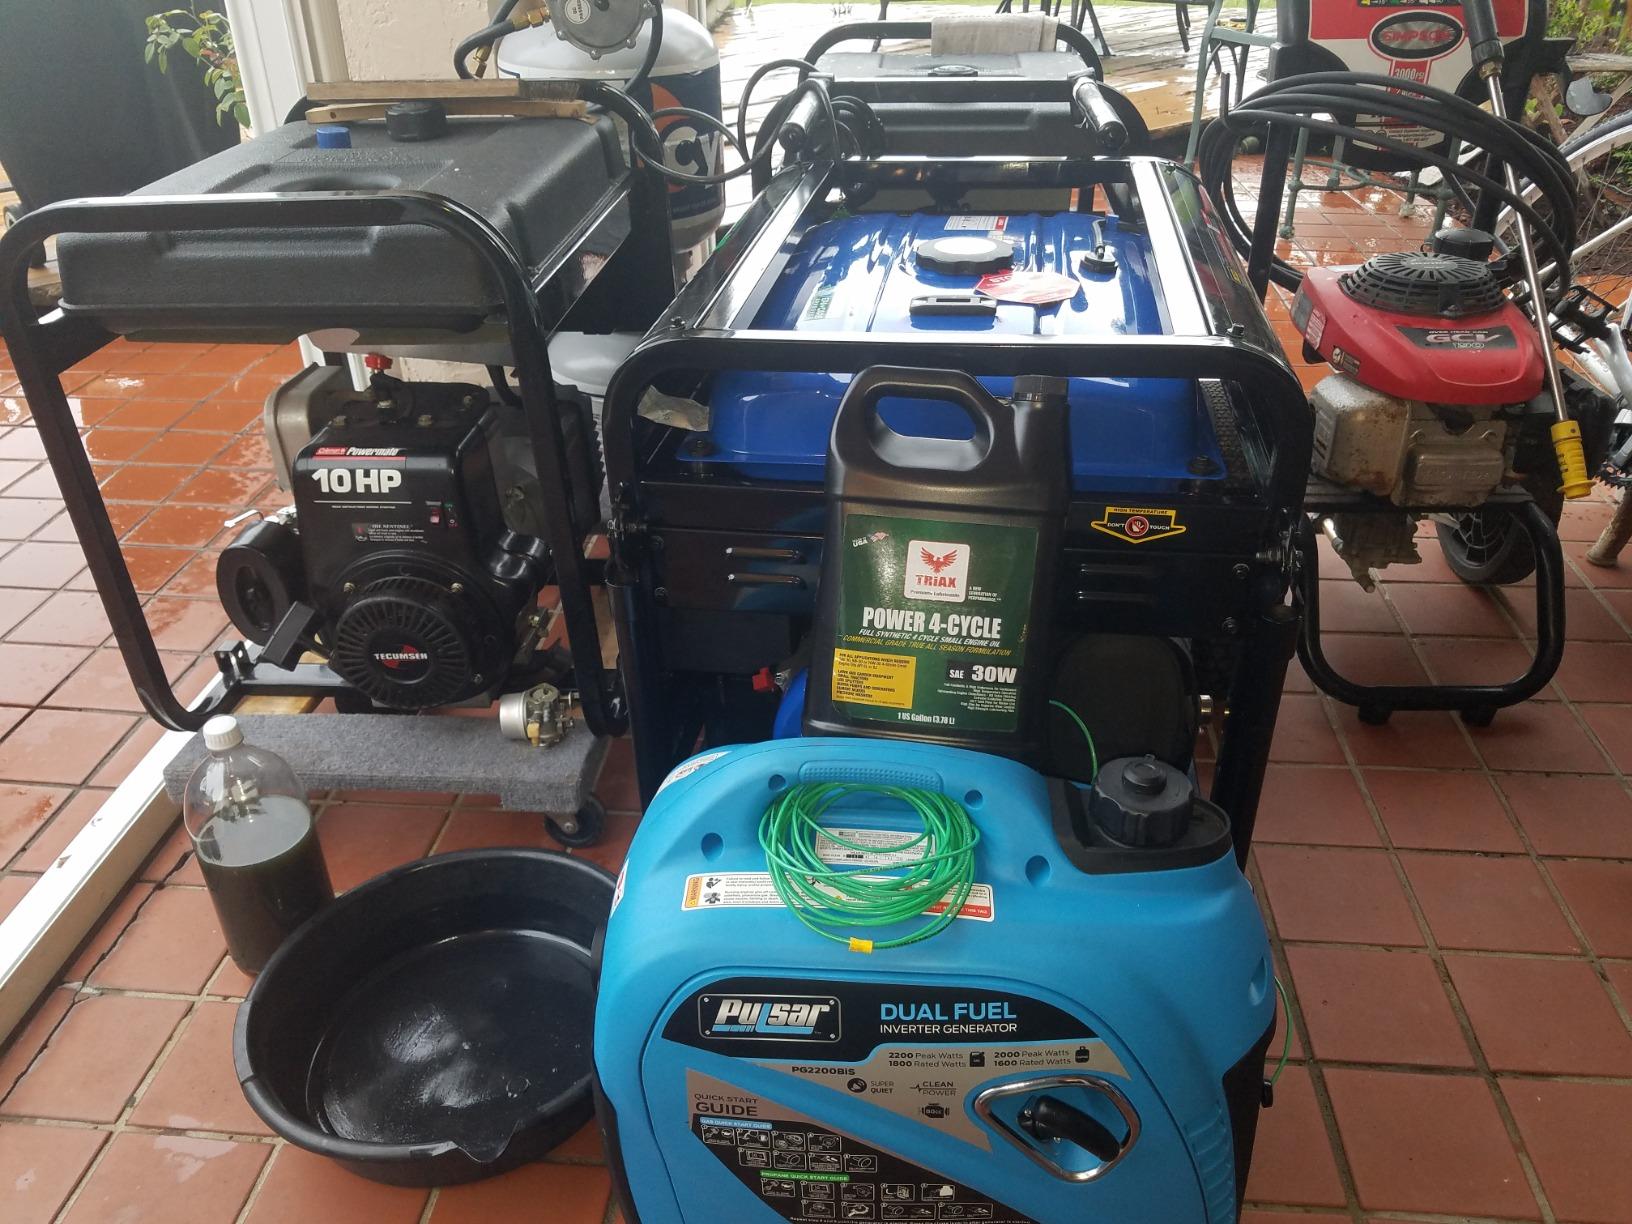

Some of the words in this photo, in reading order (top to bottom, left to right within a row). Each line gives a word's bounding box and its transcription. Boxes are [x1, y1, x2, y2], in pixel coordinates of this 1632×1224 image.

[1426, 334, 1503, 343] GCV
[862, 606, 926, 632] POWER
[928, 612, 1002, 639] 4-CYCLE
[858, 628, 875, 637] FULL
[875, 630, 911, 640] SYNTHETIC
[918, 634, 939, 643] CYCLE
[939, 636, 963, 645] SMALL
[963, 638, 989, 647] ENGINE
[989, 640, 1000, 648] OIL
[842, 634, 884, 646] COMMERCIAL
[884, 638, 907, 648] GRADE
[939, 644, 966, 653] SEASON
[966, 646, 1012, 657] FORMULATION
[949, 669, 965, 679] SAE
[971, 664, 1017, 684] 30W
[901, 712, 911, 721] US
[911, 713, 932, 723] Gallon
[880, 1003, 948, 1021] DUAL
[954, 1002, 1017, 1020] FUEL
[879, 1023, 942, 1034] INVERTER
[942, 1023, 1017, 1034] GENERATOR
[888, 1051, 914, 1059] 2200
[937, 1051, 964, 1059] Watts
[994, 1050, 1020, 1058] 2000
[1021, 1049, 1043, 1058] Peak
[1045, 1049, 1070, 1057] Watts
[888, 1060, 913, 1068] 1800
[913, 1060, 939, 1068] Rated
[940, 1060, 967, 1068] Watts
[994, 1059, 1018, 1067] 1600
[1019, 1058, 1043, 1066] Rated
[1045, 1057, 1071, 1065] Watts
[694, 1093, 726, 1101] QUICK
[726, 1096, 758, 1104] START
[922, 1089, 957, 1097] POWER
[695, 1102, 758, 1117] GUIDE
